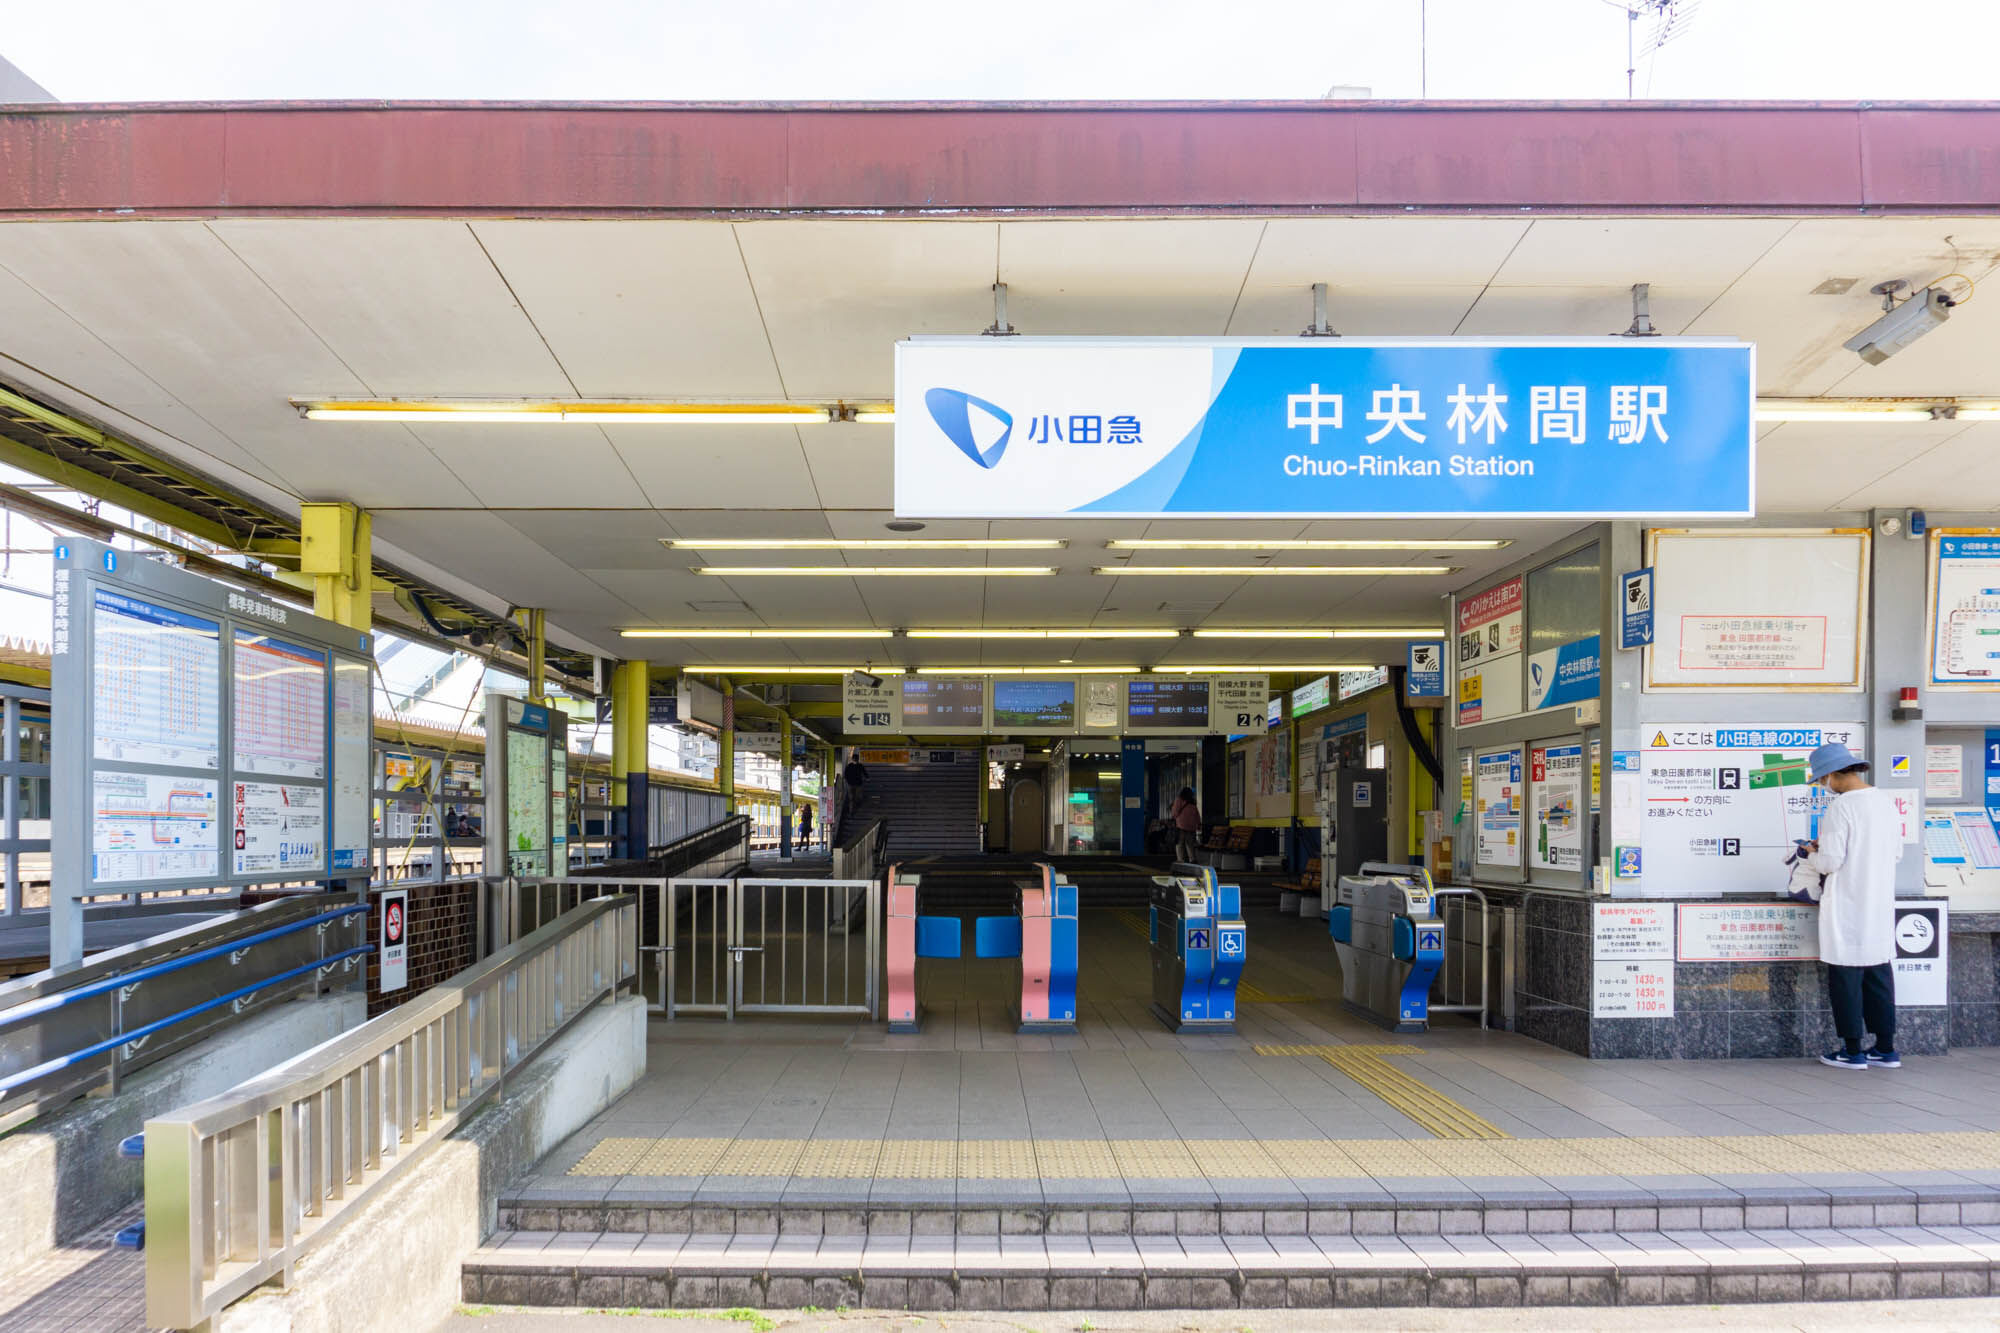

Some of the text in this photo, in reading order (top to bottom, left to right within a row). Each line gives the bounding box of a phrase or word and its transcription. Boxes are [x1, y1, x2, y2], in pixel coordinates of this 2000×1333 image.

[1287, 383, 1669, 445] 中央林間駅
[1028, 415, 1143, 445] 小田急
[1283, 454, 1534, 477] Chuo-Rinkan Station
[54, 568, 69, 655] 標準発車時刻表
[228, 592, 287, 625] 標準発車時刻表
[1673, 731, 1852, 747] ここは 小田急線のりば です
[1650, 768, 1712, 777] 東急田園都市線
[1694, 795, 1732, 805] の方向に
[1647, 808, 1713, 817] お進みください
[1689, 838, 1717, 846] 小田急線
[1898, 963, 1932, 972] 終日禁煙
[1635, 975, 1655, 985] 1430
[1636, 987, 1656, 998] 1430
[1637, 1001, 1657, 1011] 1100
